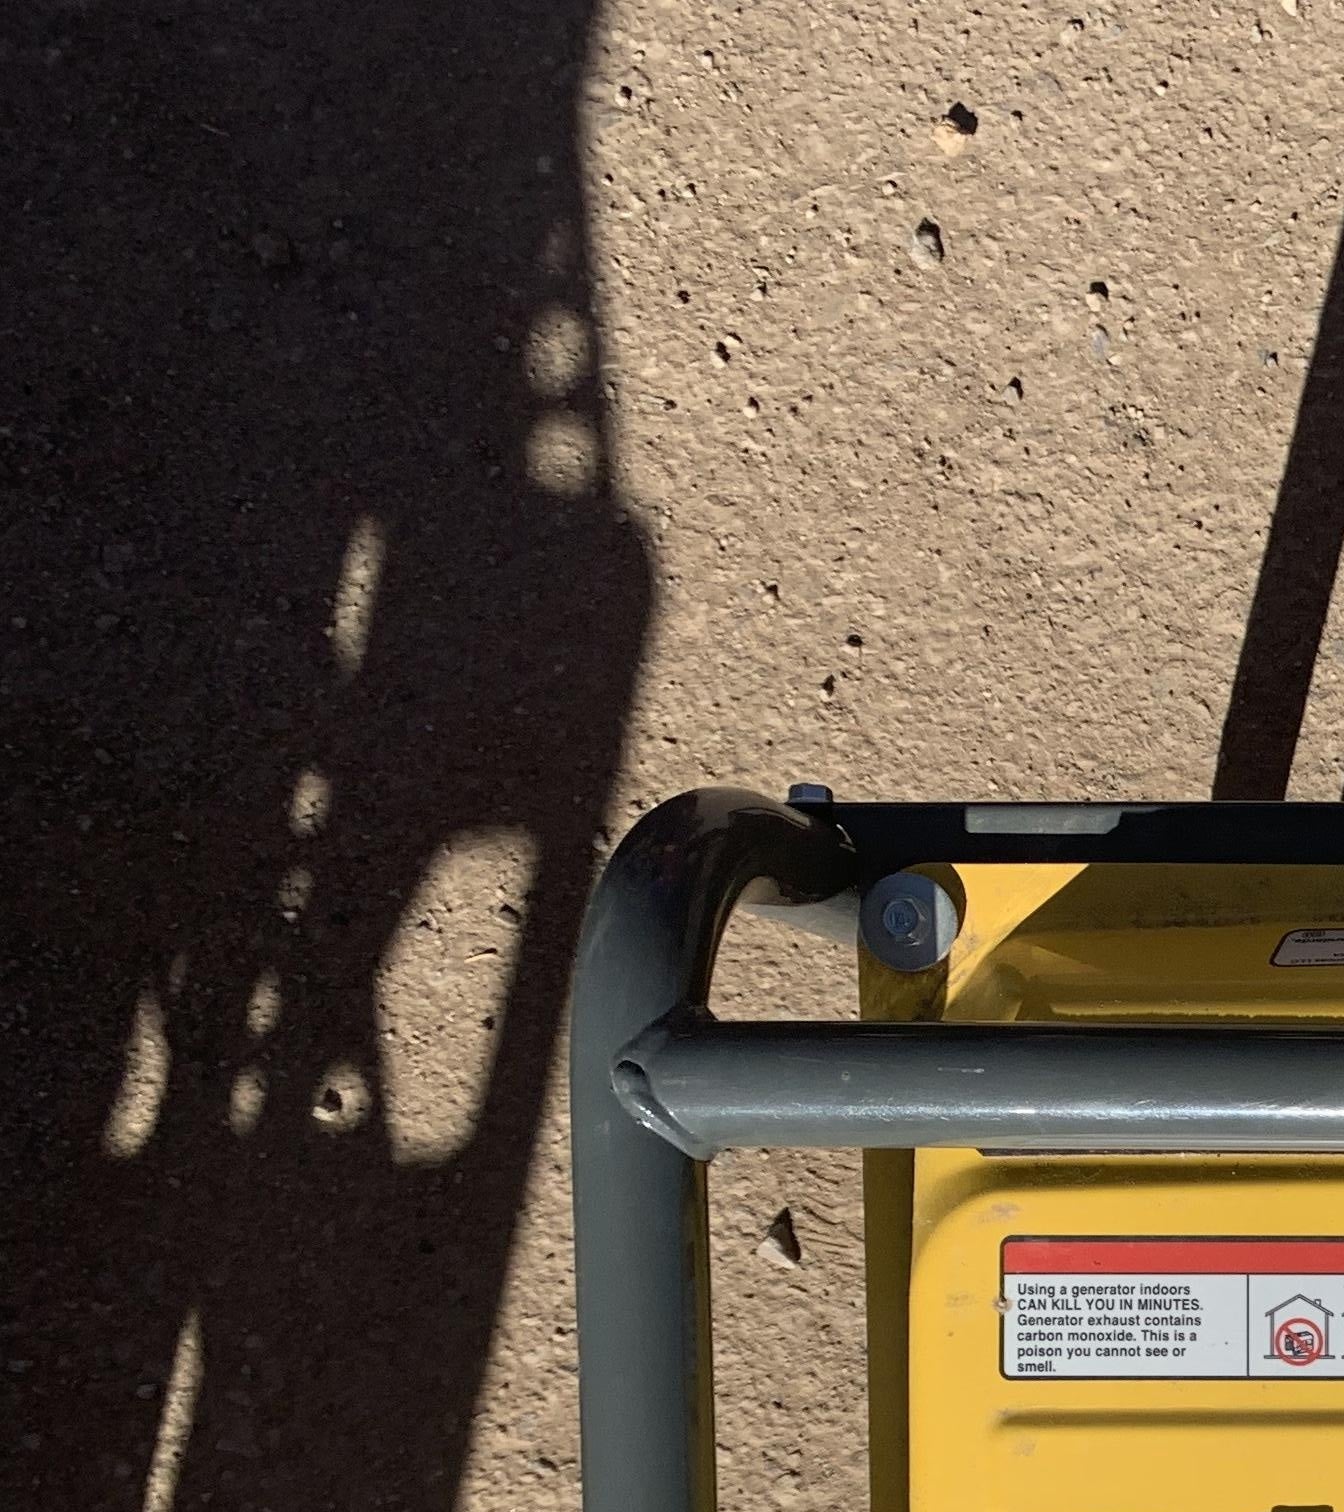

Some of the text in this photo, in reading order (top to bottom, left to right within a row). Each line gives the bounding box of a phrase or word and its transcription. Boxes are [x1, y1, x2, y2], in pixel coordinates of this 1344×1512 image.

[1017, 1283, 1191, 1299] Using a generator indoors
[1017, 1299, 1204, 1311] CAN KILL YOU IN MINUTES.
[1017, 1314, 1202, 1326] Generator exhaust contains
[1016, 1330, 1197, 1342] carbon monoxide. This is a
[1017, 1346, 1187, 1362] poison you cannot see or
[1017, 1360, 1057, 1372] smell.
